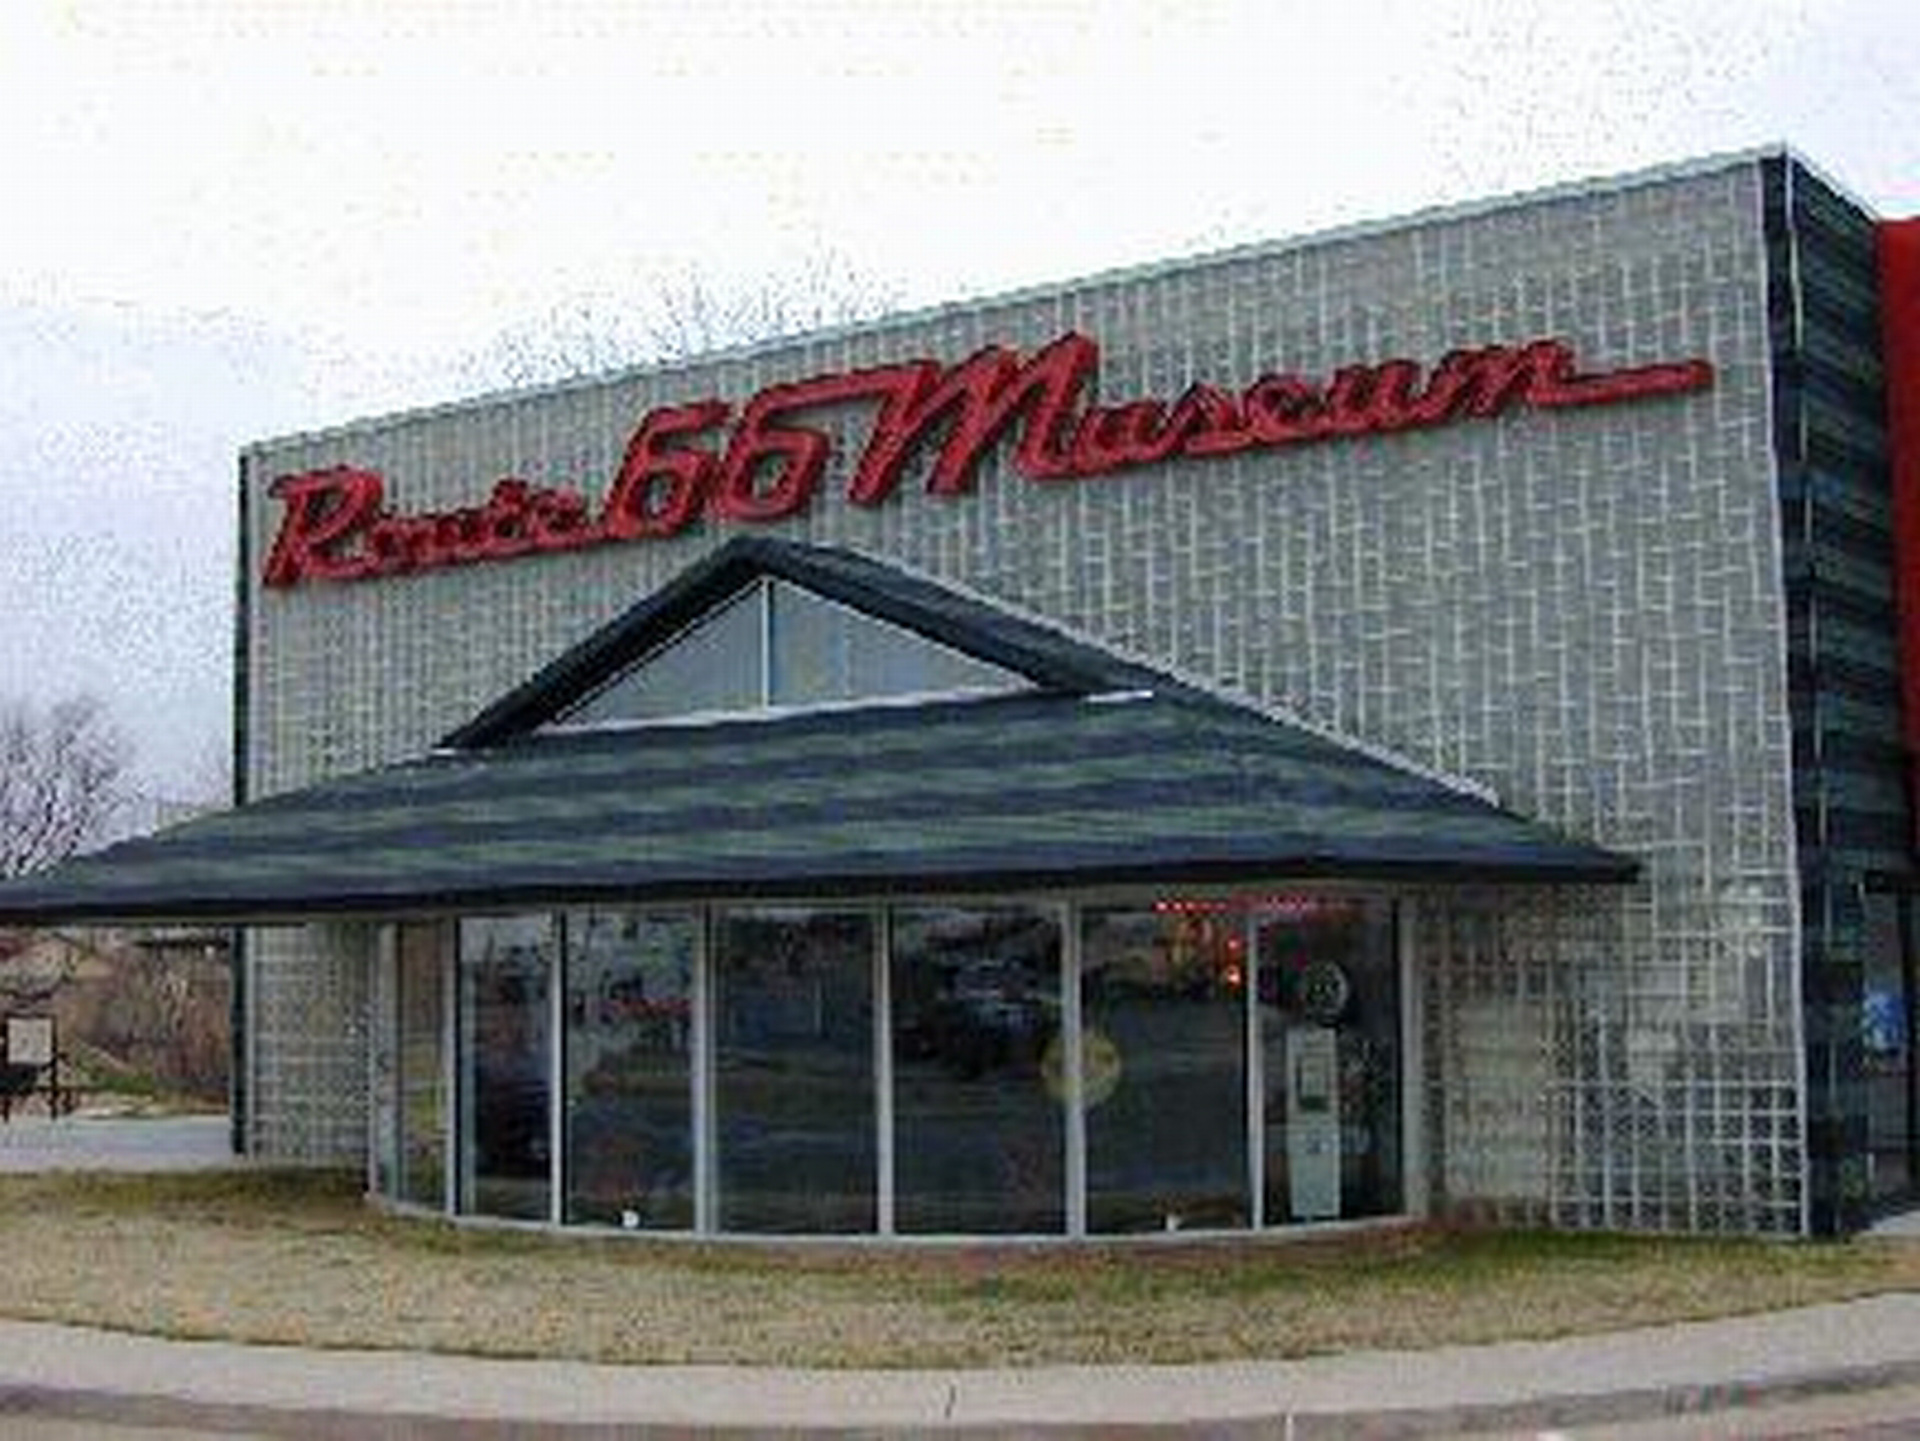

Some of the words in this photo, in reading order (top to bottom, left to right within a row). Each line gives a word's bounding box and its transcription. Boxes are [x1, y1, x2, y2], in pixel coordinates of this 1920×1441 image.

[264, 465, 602, 587] Route
[604, 370, 852, 540] 66
[848, 331, 1711, 505] Museum
